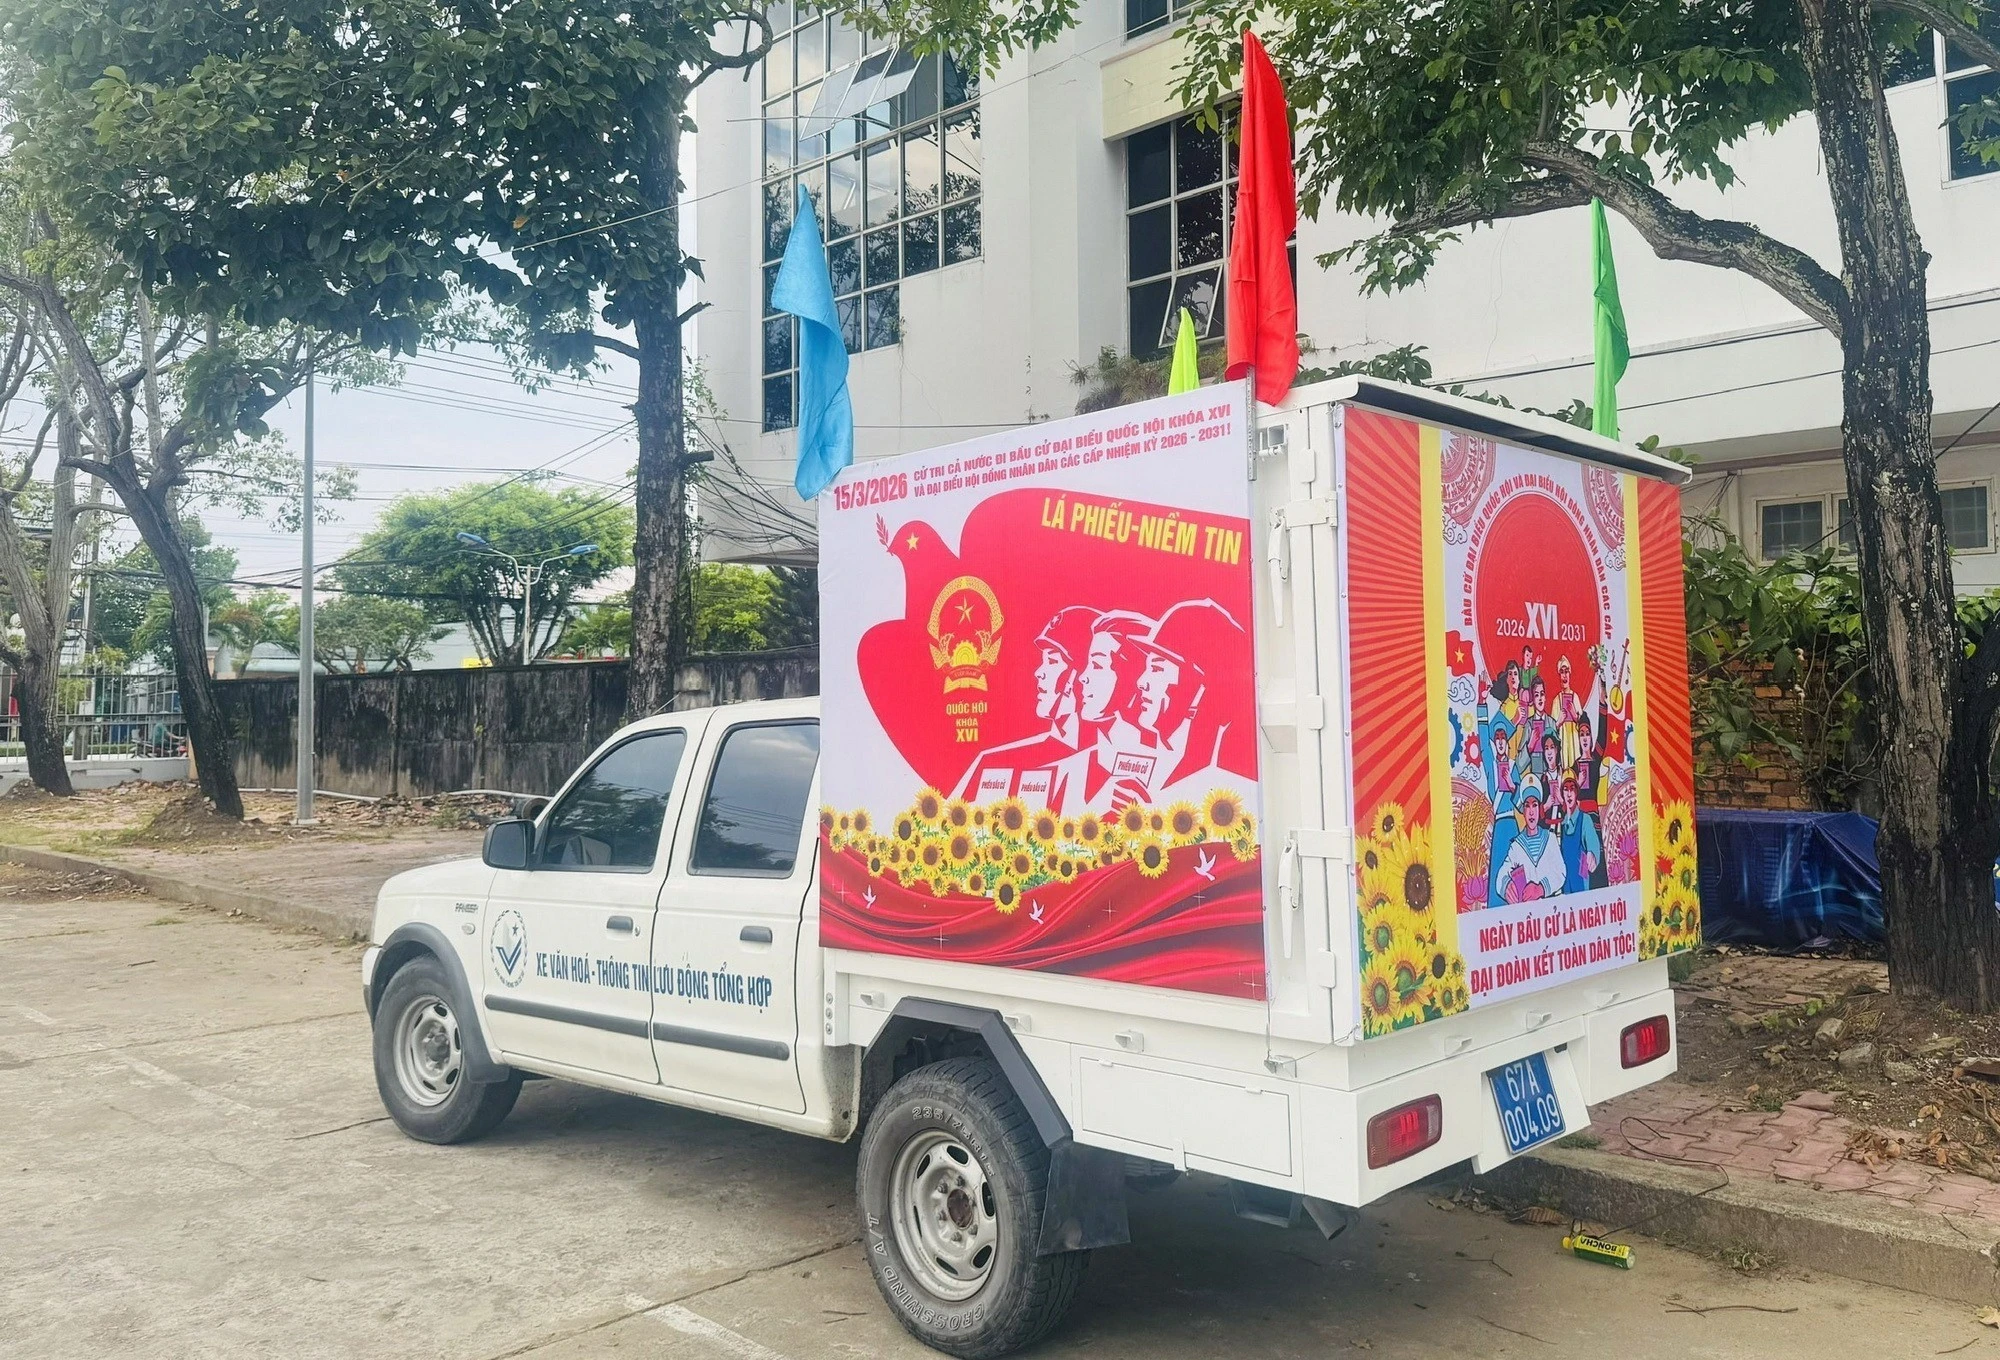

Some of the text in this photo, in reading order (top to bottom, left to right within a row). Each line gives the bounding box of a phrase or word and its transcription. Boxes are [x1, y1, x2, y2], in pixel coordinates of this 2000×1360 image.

[914, 404, 1231, 481] CỬ TRI CẢ NƯỚC ĐI BẦU CỬ ĐẠI BIỂU QUỐC HỘI KHÓA XVI
[914, 484, 925, 497] VÀ
[927, 482, 941, 497] ĐẠI
[943, 475, 962, 492] BIỂU
[965, 474, 980, 488] HỘI
[982, 468, 1006, 484] ĐỒNG
[1009, 463, 1035, 479] NHÂN
[1038, 458, 1058, 473] DÂN
[1061, 453, 1080, 468] CÁC
[1083, 447, 1103, 464] CẤP
[1106, 442, 1140, 460] NHIỆM
[1144, 436, 1158, 452] KỲ
[1161, 433, 1187, 449] 2026
[1199, 422, 1231, 442] 2031!
[833, 472, 907, 511] 15/3/2026
[1500, 479, 1514, 498] HỘI
[1513, 474, 1524, 489] VÀ
[1524, 474, 1537, 489] ĐẠI
[1041, 494, 1067, 530] LÁ
[1204, 526, 1242, 565] TIN
[1496, 601, 1586, 642] 2026 XVI 2031
[946, 701, 988, 715] QUỐC HỘI
[956, 717, 978, 727] KHÓA
[956, 728, 979, 742] XVI
[1479, 897, 1627, 952] NGÀY BẦU CỬ LÀ NGÀY HỘI
[536, 952, 548, 977] XE
[550, 949, 569, 980] VĂN
[571, 953, 591, 984] HOÁ
[597, 955, 630, 989] THÔNG
[632, 963, 650, 992] TIN
[677, 963, 709, 1004] ĐỘNG
[712, 961, 744, 1004] TỔNG
[747, 975, 772, 1013] HỢP
[1471, 930, 1636, 996] ĐẠI ĐOÀN KẾT TOÀN DÂN TỘC!
[1505, 1059, 1540, 1101] 67A
[1504, 1093, 1560, 1146] 004.09
[1580, 1238, 1618, 1252] BONCHA
[867, 1212, 985, 1331] CROSSWIND A/T
